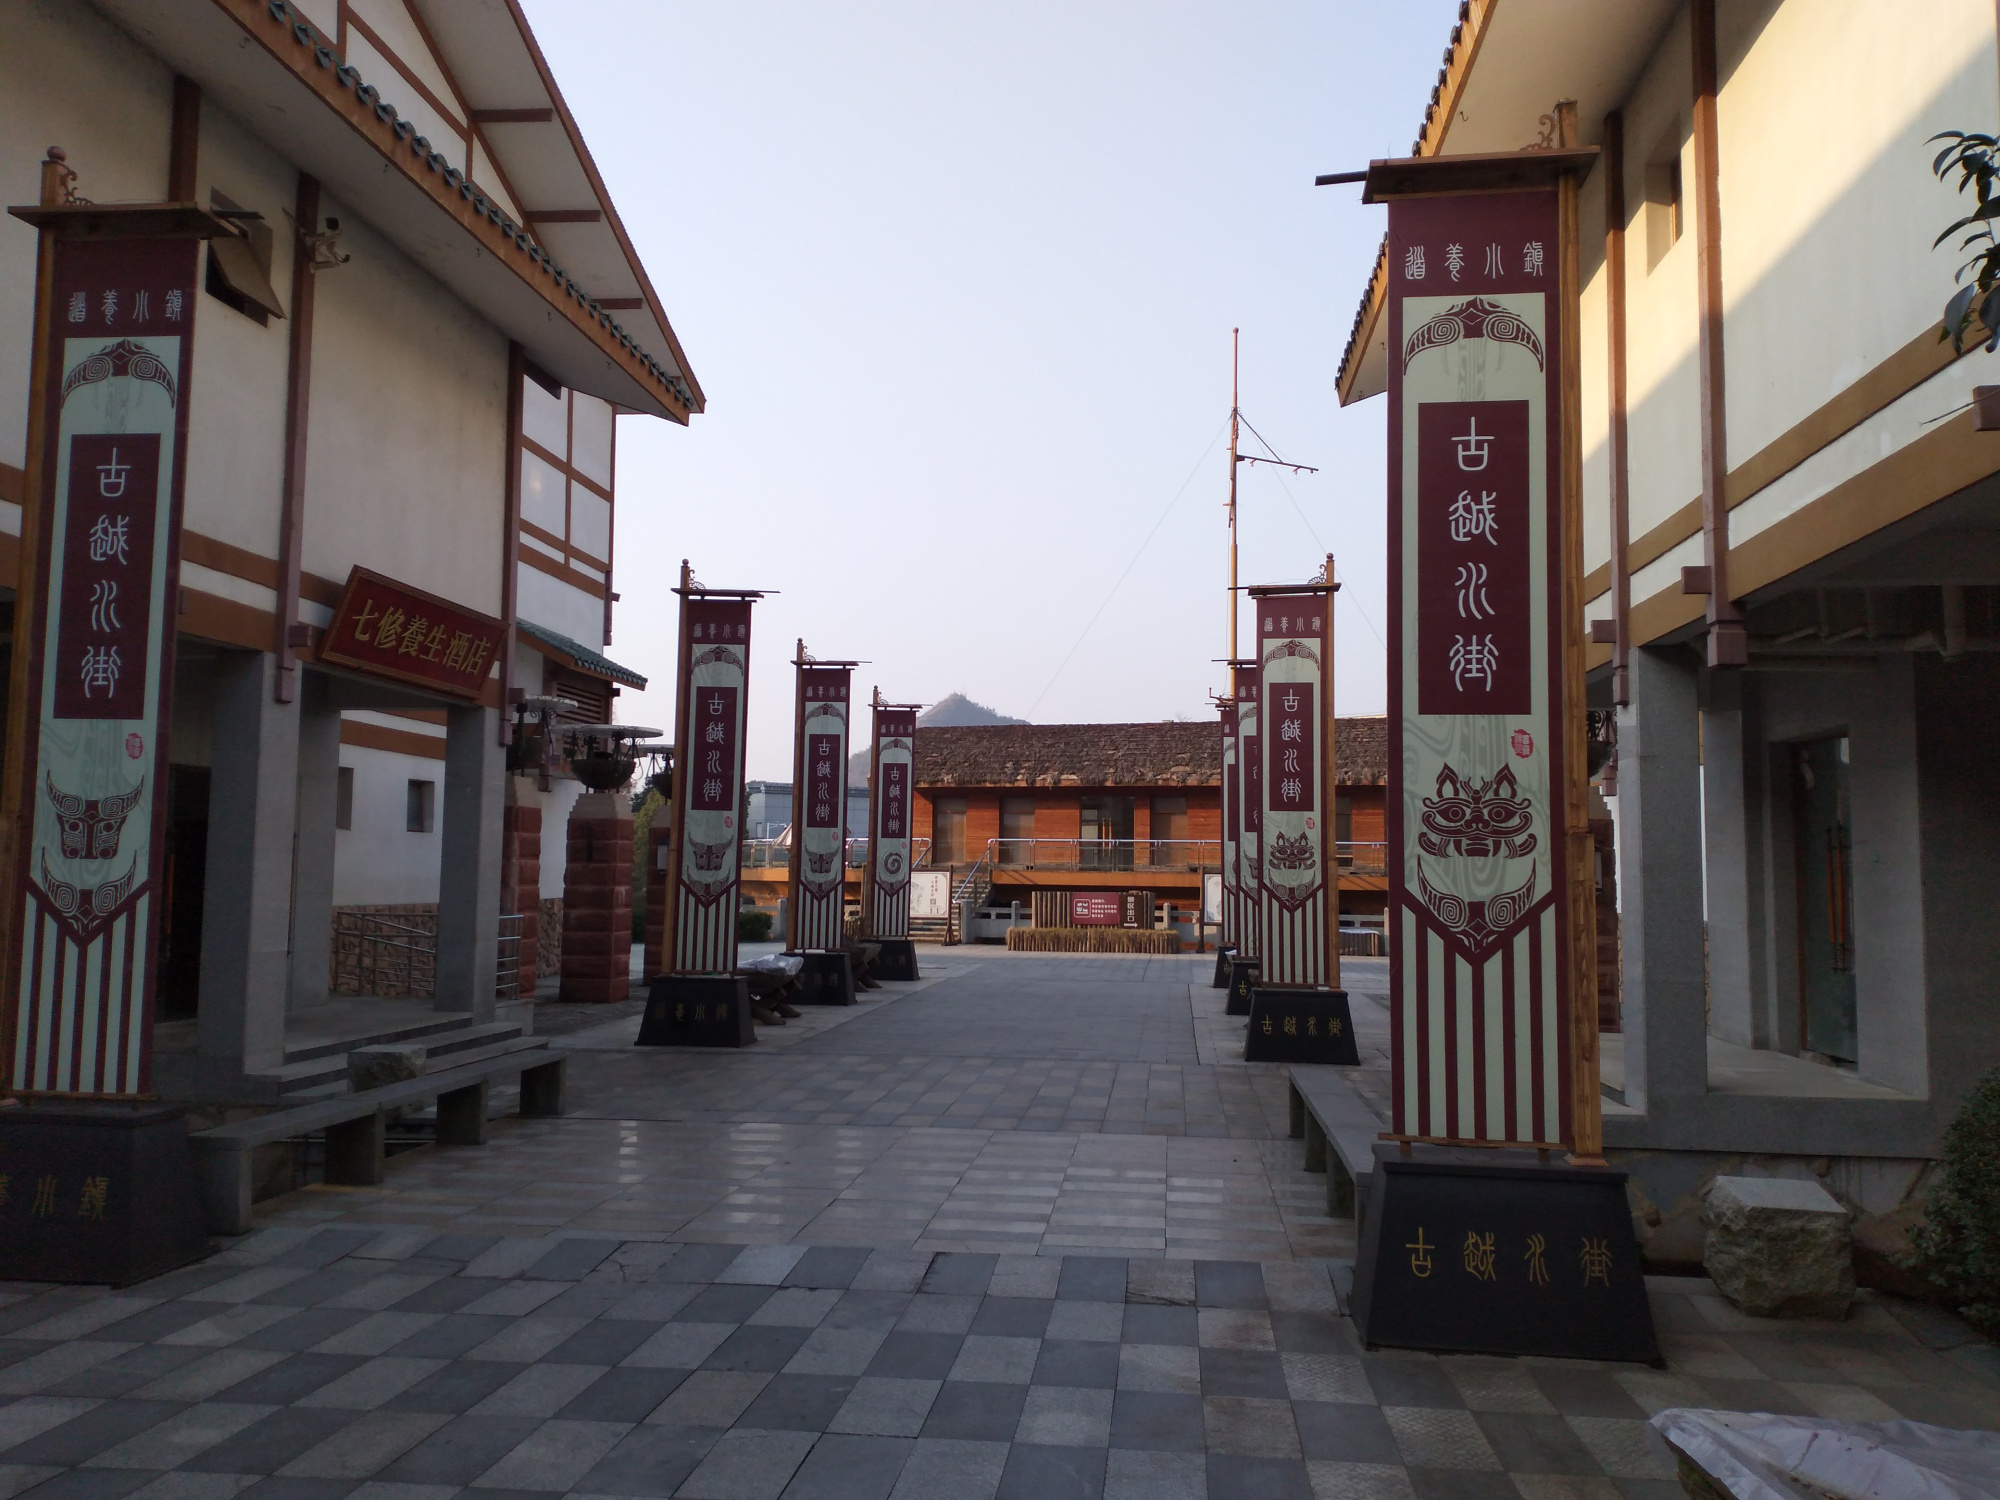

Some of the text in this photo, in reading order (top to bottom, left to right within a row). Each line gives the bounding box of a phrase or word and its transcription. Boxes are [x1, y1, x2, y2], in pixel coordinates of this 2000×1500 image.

[80, 447, 132, 699] 古越水街
[1448, 416, 1499, 692] 古越水街
[352, 599, 491, 676] 七修養生酒店
[703, 692, 725, 802] 古越水街
[815, 738, 832, 822] 古越水街
[1280, 688, 1303, 804] 古越水街
[887, 766, 901, 834] 古越水街
[1127, 896, 1135, 922] 景区出口
[1261, 1014, 1343, 1038] 古越水街
[1405, 1227, 1613, 1288] 古越水街
